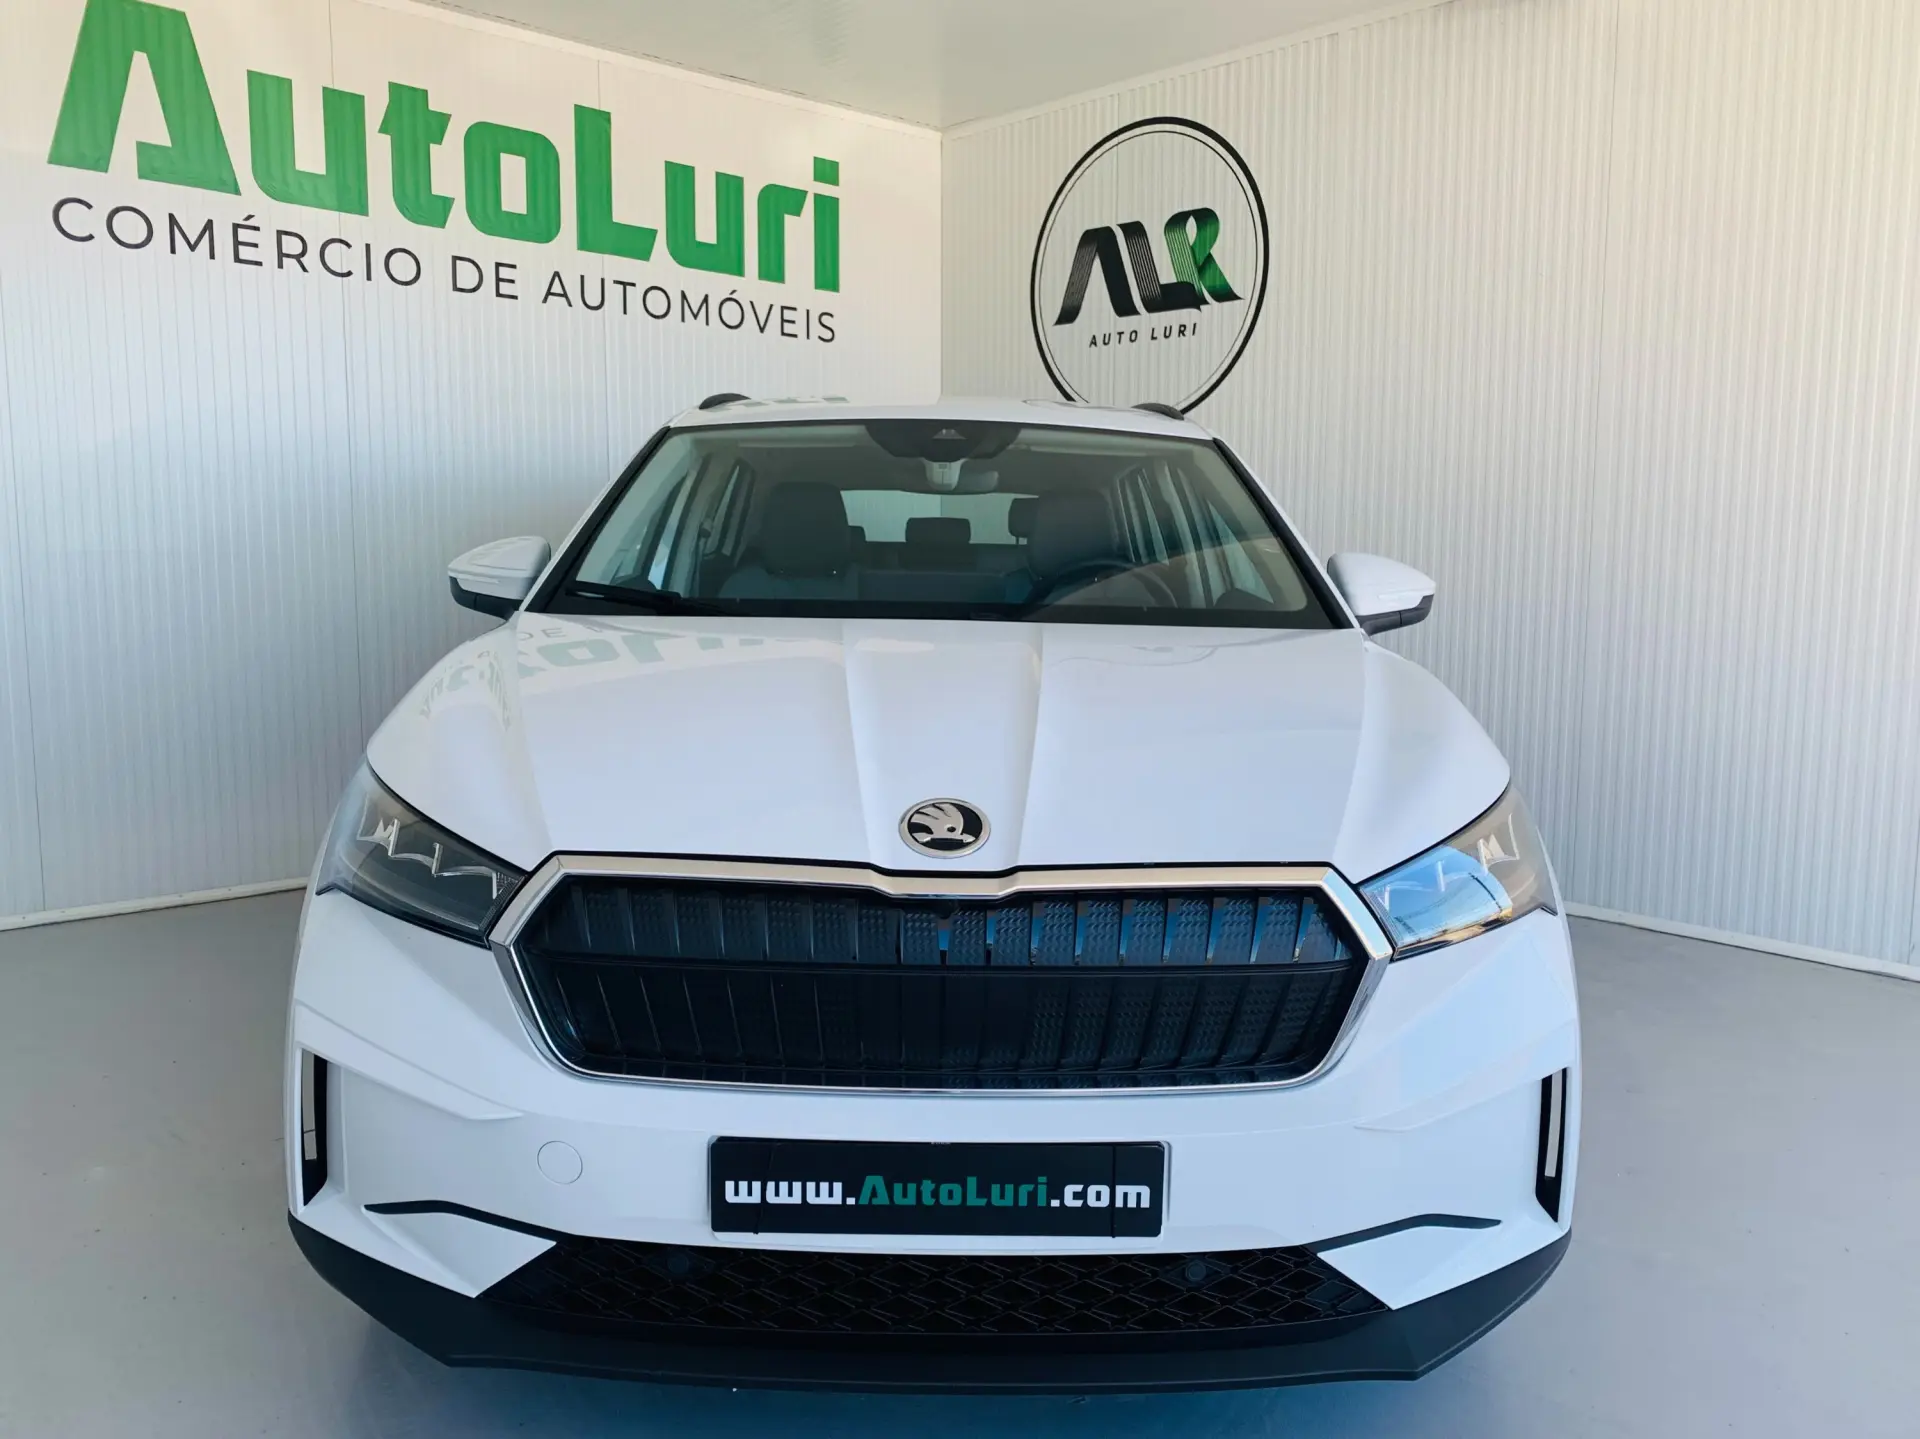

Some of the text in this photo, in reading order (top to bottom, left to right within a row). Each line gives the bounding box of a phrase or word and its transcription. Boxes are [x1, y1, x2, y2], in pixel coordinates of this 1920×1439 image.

[47, 0, 841, 293] AutoLuri
[51, 197, 837, 344] COMÉRCIO DE AUTOMÓVEIS
[1089, 323, 1197, 347] AUTO LURI
[724, 1174, 1151, 1209] www.AutoLuri.com
